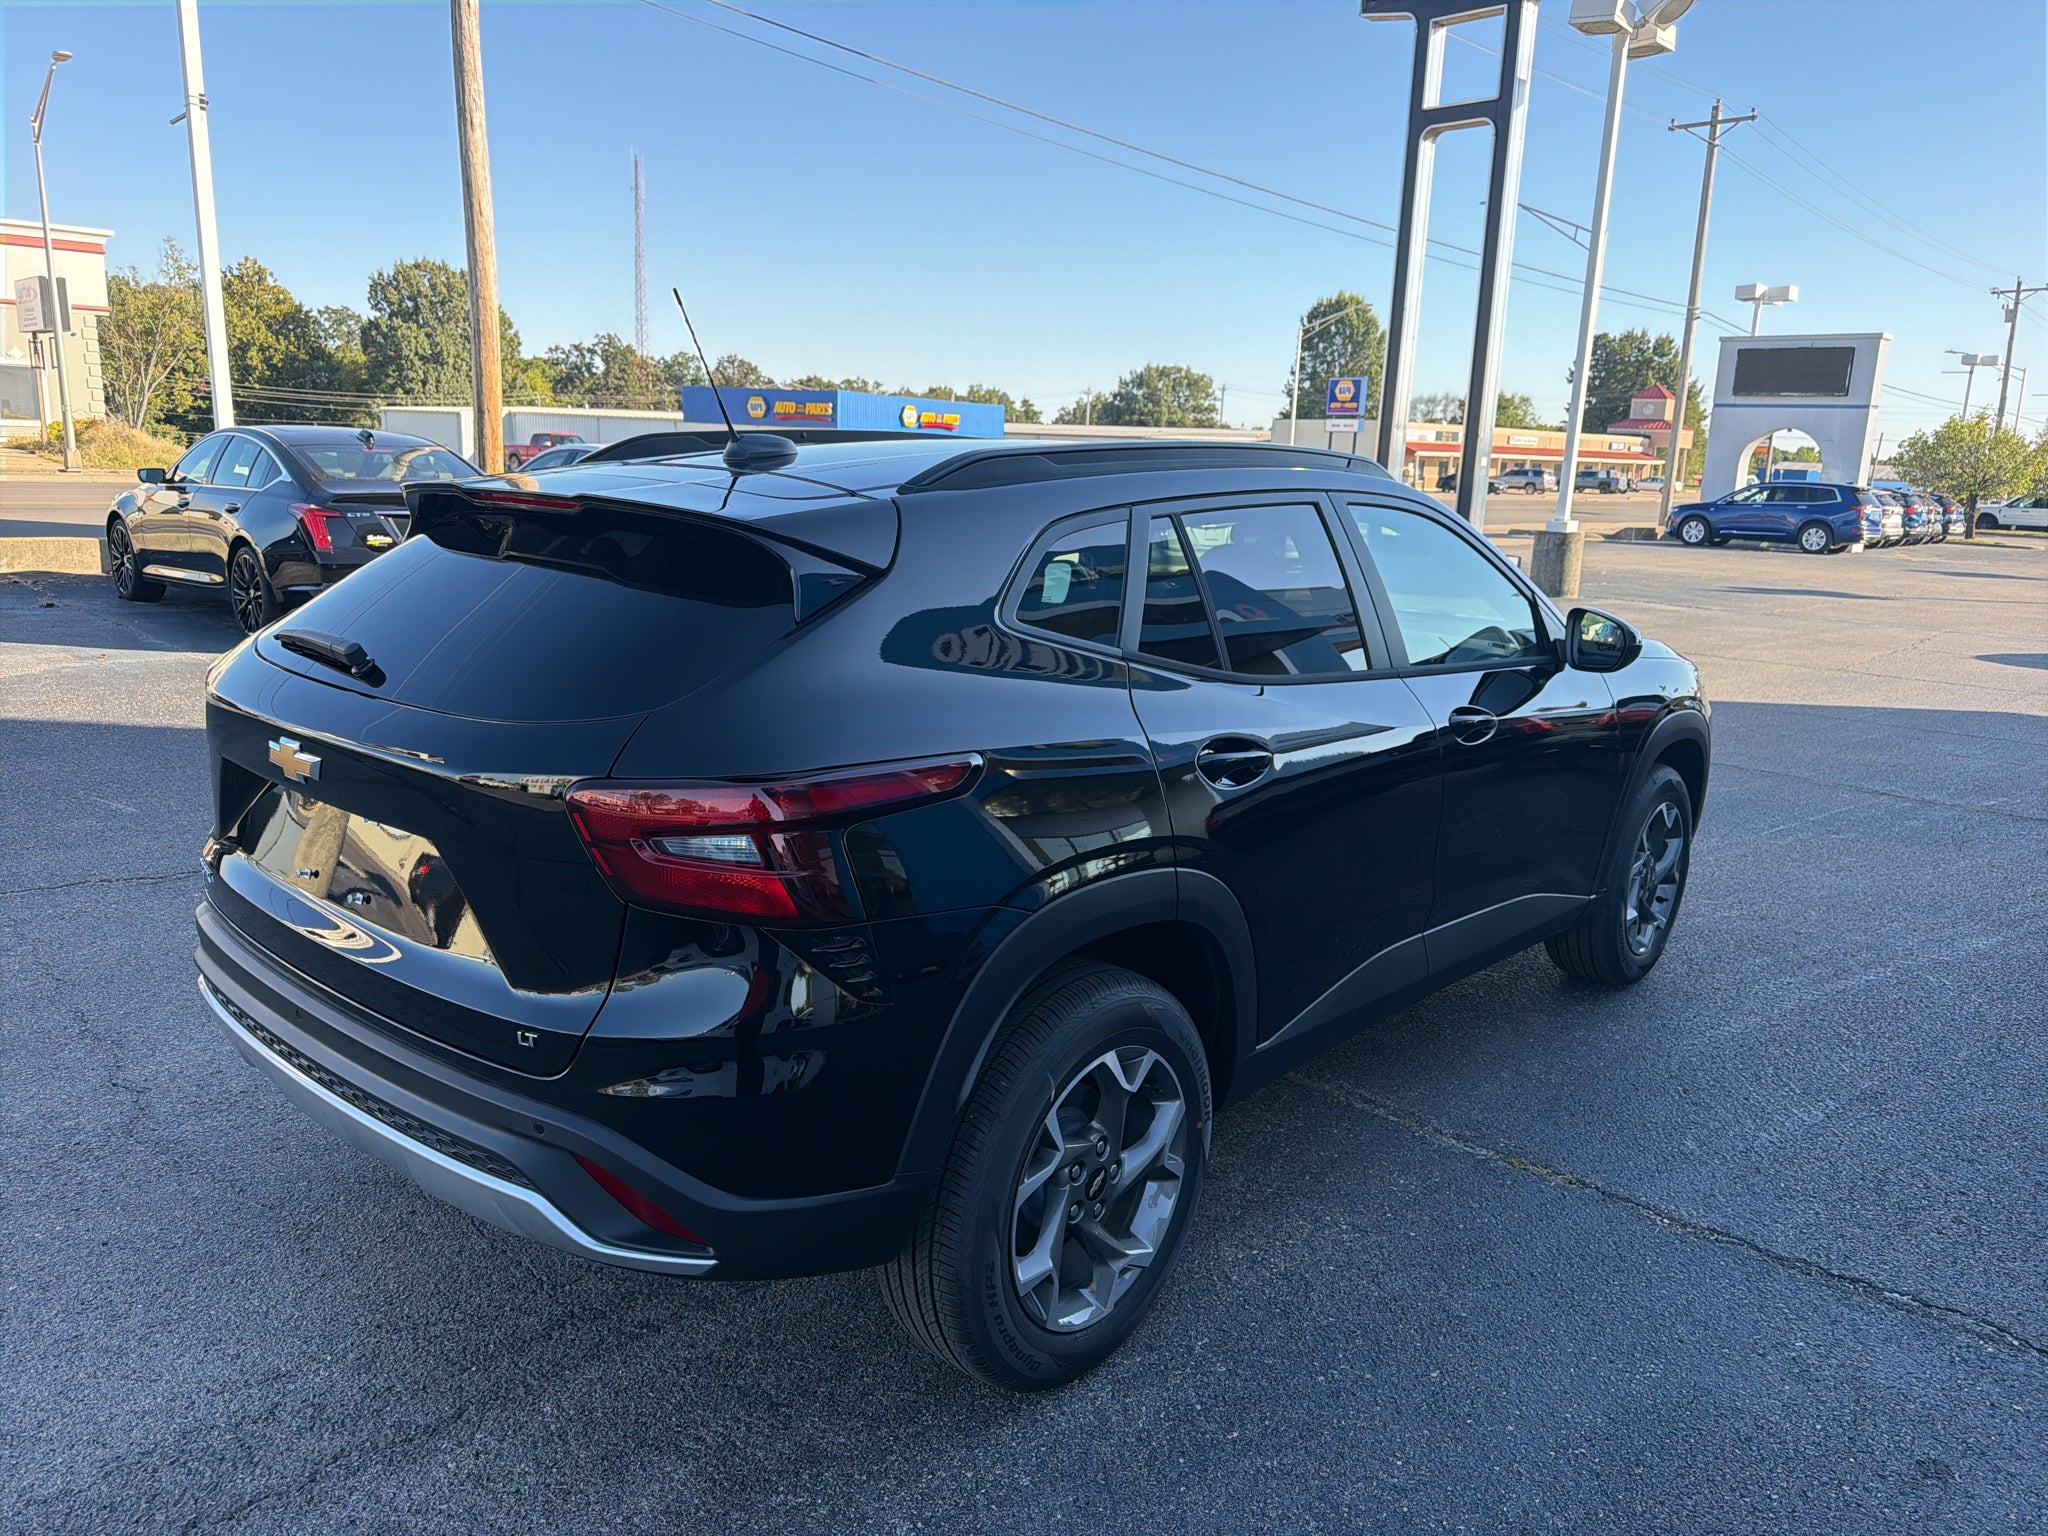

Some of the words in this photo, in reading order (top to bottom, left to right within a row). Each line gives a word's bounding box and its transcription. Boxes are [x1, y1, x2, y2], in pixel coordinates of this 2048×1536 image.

[774, 401, 797, 414] AUTO
[805, 402, 833, 416] PARTS
[516, 1031, 538, 1048] LT
